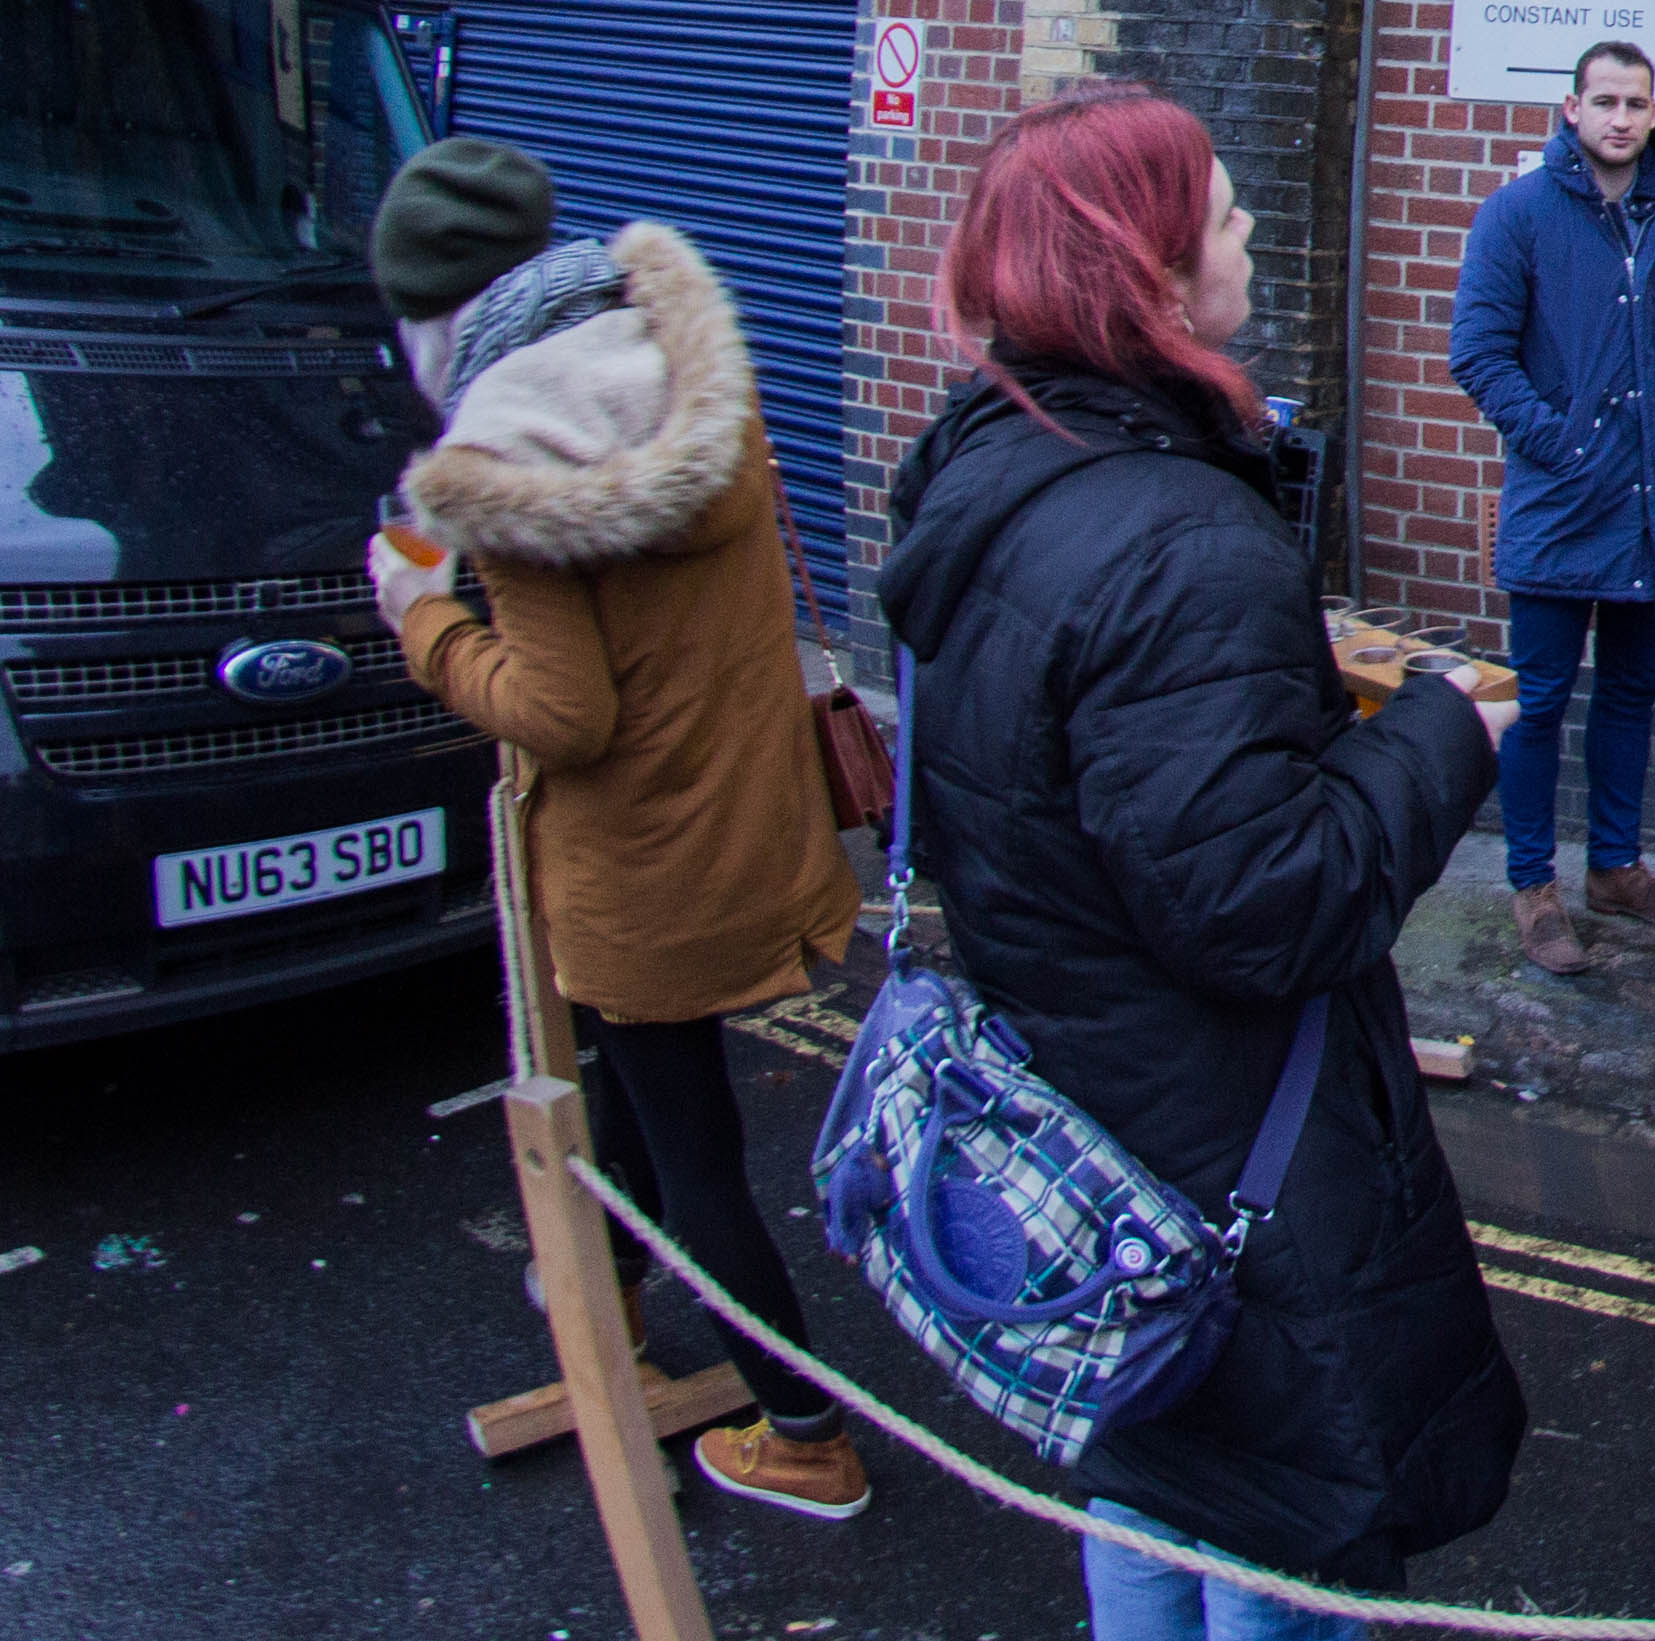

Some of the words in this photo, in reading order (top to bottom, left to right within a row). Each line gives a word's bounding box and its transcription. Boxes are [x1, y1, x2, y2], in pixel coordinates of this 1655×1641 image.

[1484, 4, 1592, 26] CONSTANT
[1604, 9, 1644, 28] USE
[257, 651, 325, 688] Ford
[181, 840, 318, 911] NU63
[333, 819, 424, 882] SBO
